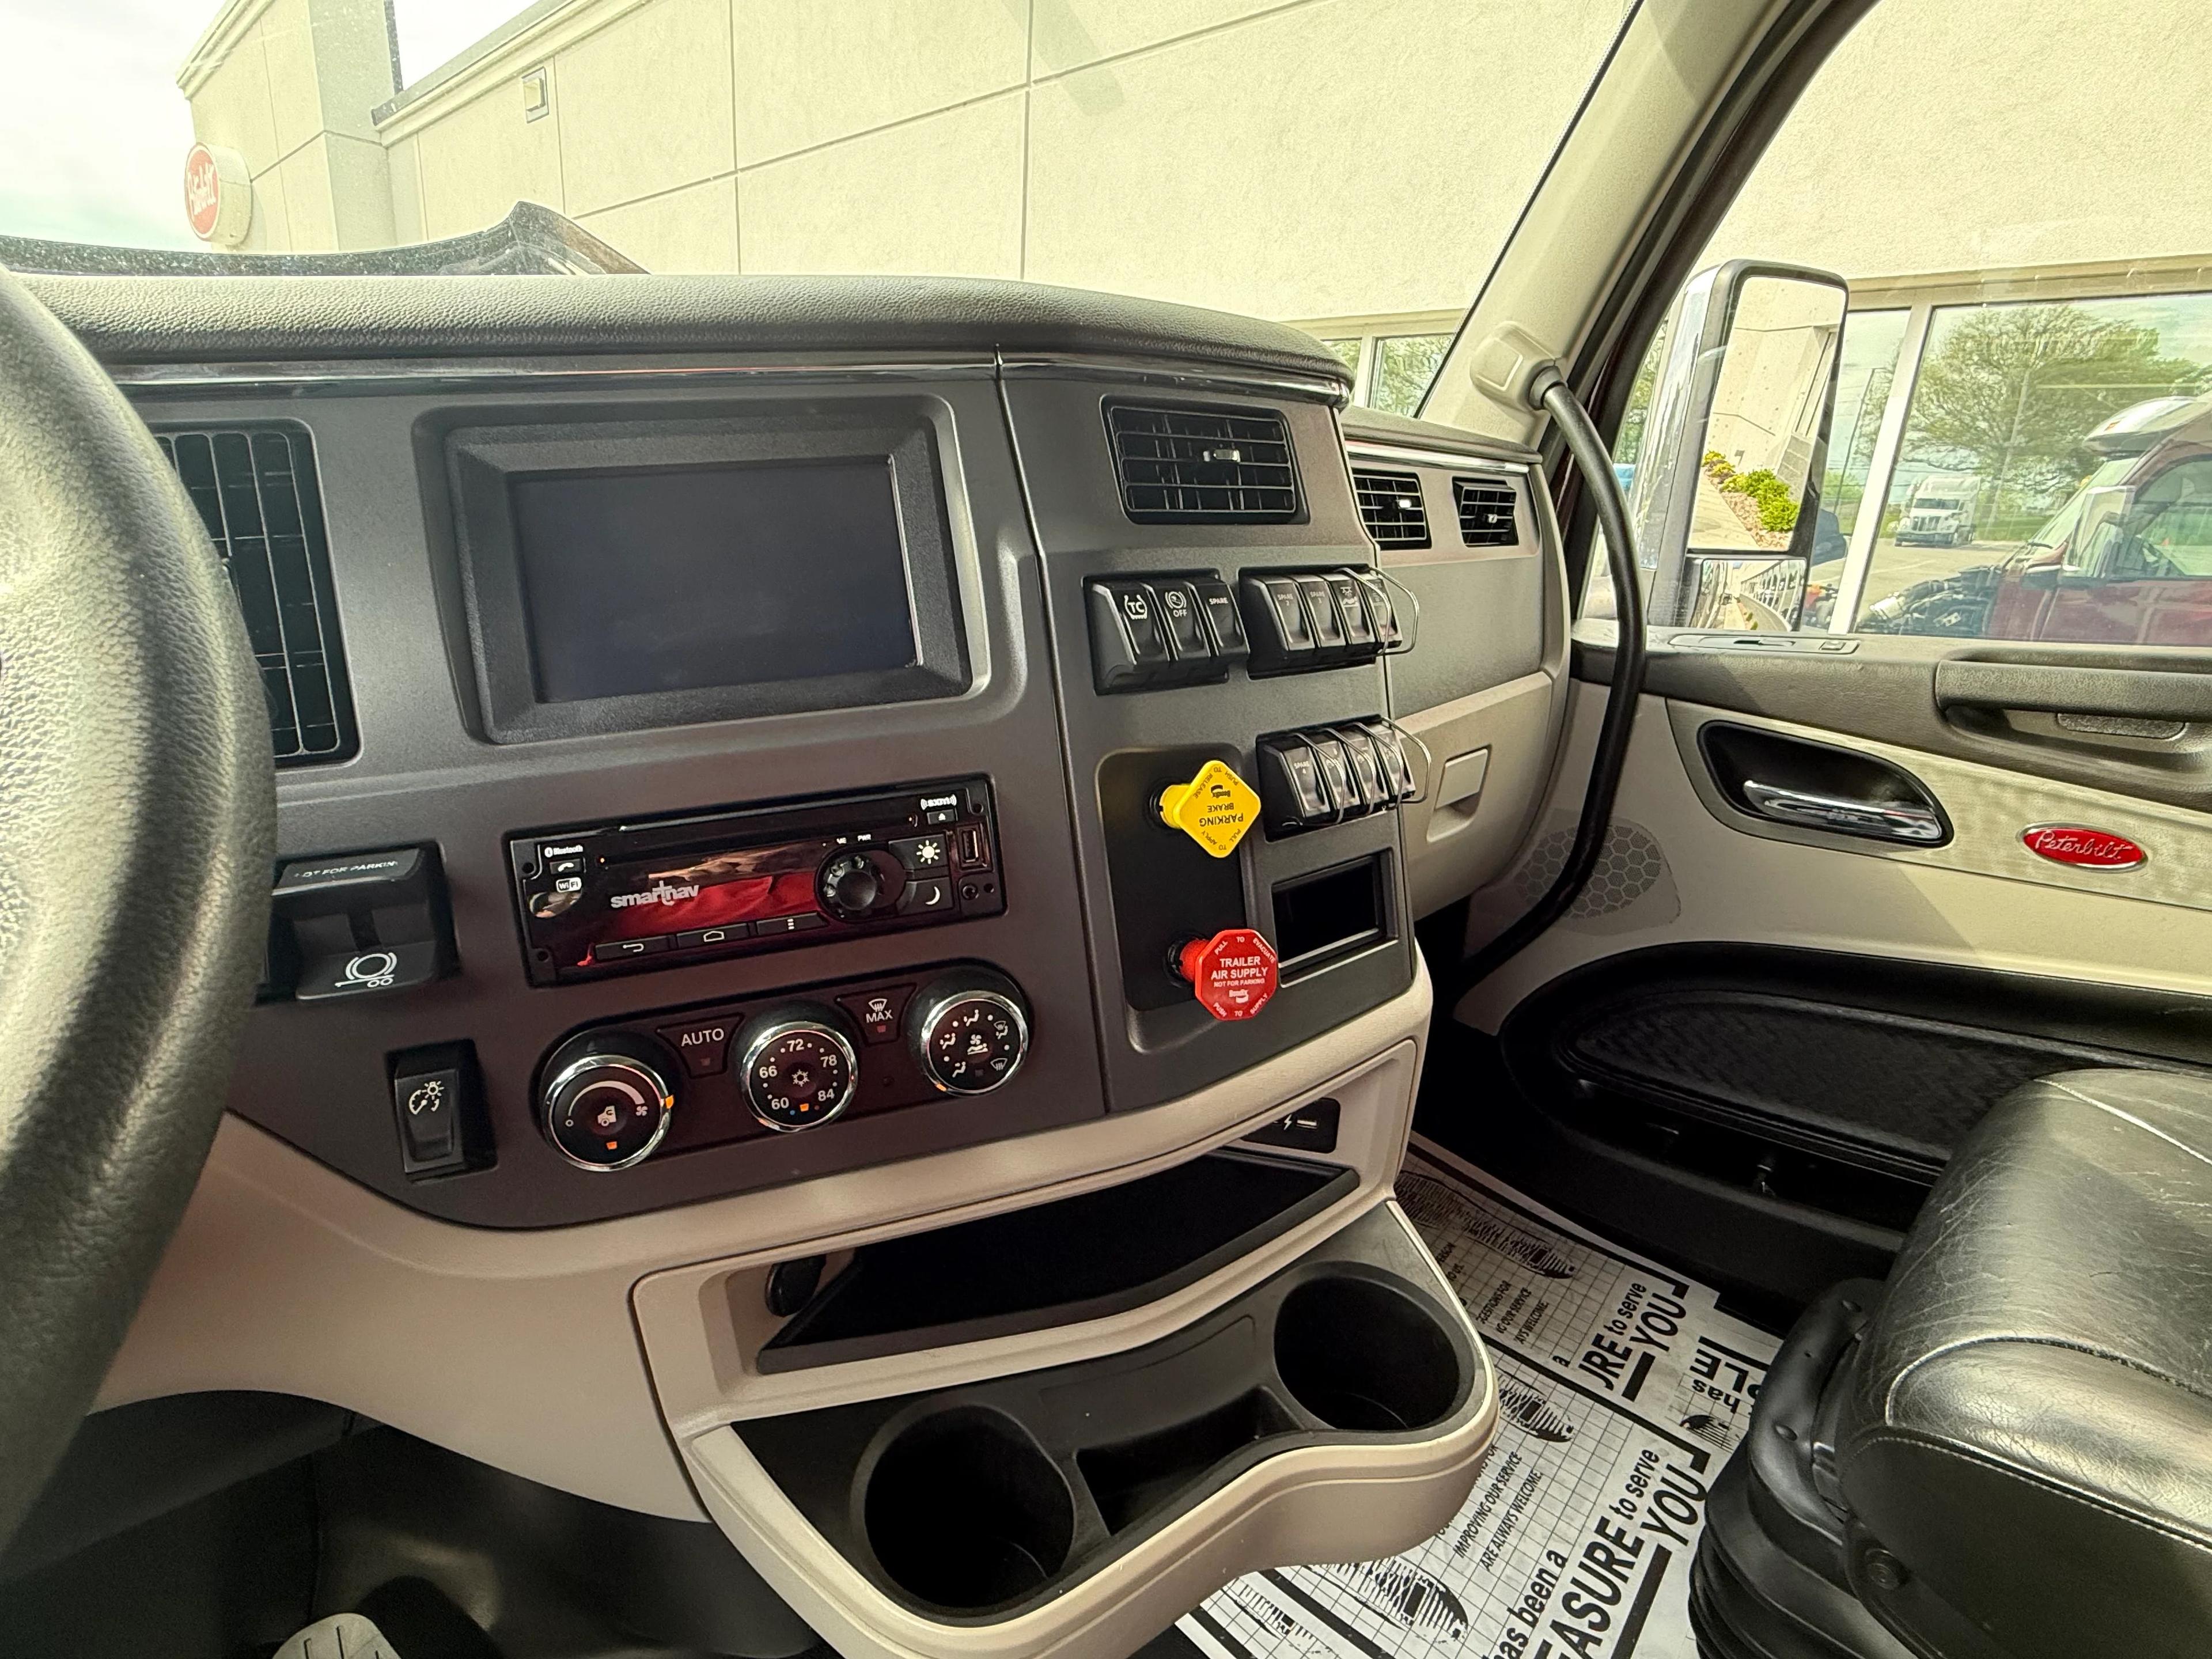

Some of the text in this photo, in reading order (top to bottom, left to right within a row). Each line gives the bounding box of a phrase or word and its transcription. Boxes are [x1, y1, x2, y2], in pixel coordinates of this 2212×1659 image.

[1128, 601, 1145, 613] TC
[1173, 609, 1188, 618] OFF
[1194, 773, 1213, 798] RELEASE
[1225, 771, 1238, 786] PUSH
[1207, 802, 1234, 812] BRAKE
[1199, 813, 1244, 827] PARKING
[1201, 830, 1217, 845] APPLY
[1229, 828, 1241, 842] PULL
[2035, 830, 2133, 859] Peterbilt
[611, 880, 699, 908] smartnav
[1214, 941, 1228, 955] PULL
[1252, 937, 1276, 964] EVACUATE
[1219, 956, 1261, 968] TRAILER
[1211, 967, 1268, 980] AIR SUPPLY
[1213, 1002, 1227, 1017] PUSH
[1250, 993, 1267, 1014] SUPPLY
[865, 1009, 893, 1023] MAX
[681, 1028, 725, 1047] AUTO
[786, 1038, 805, 1052] 72
[820, 1054, 837, 1068] 78
[759, 1065, 778, 1078] 66
[817, 1088, 835, 1101] 84
[771, 1097, 789, 1111] 60
[1604, 1319, 1629, 1336] to
[1618, 1282, 1647, 1319] serve
[1630, 1293, 1687, 1352] YOU
[1552, 1355, 1570, 1368] a
[1691, 1379, 1741, 1415] has
[1609, 1497, 1638, 1521] to
[1624, 1449, 1660, 1498] serve
[1452, 1501, 1492, 1559] IMPROVING
[1484, 1483, 1504, 1505] OUR
[1496, 1451, 1522, 1488] SERVICE
[1640, 1464, 1708, 1547] YOU
[1479, 1470, 1544, 1572] ARE ALWAYS WELCOME.
[1507, 1567, 1559, 1629] been
[1546, 1550, 1568, 1569] a
